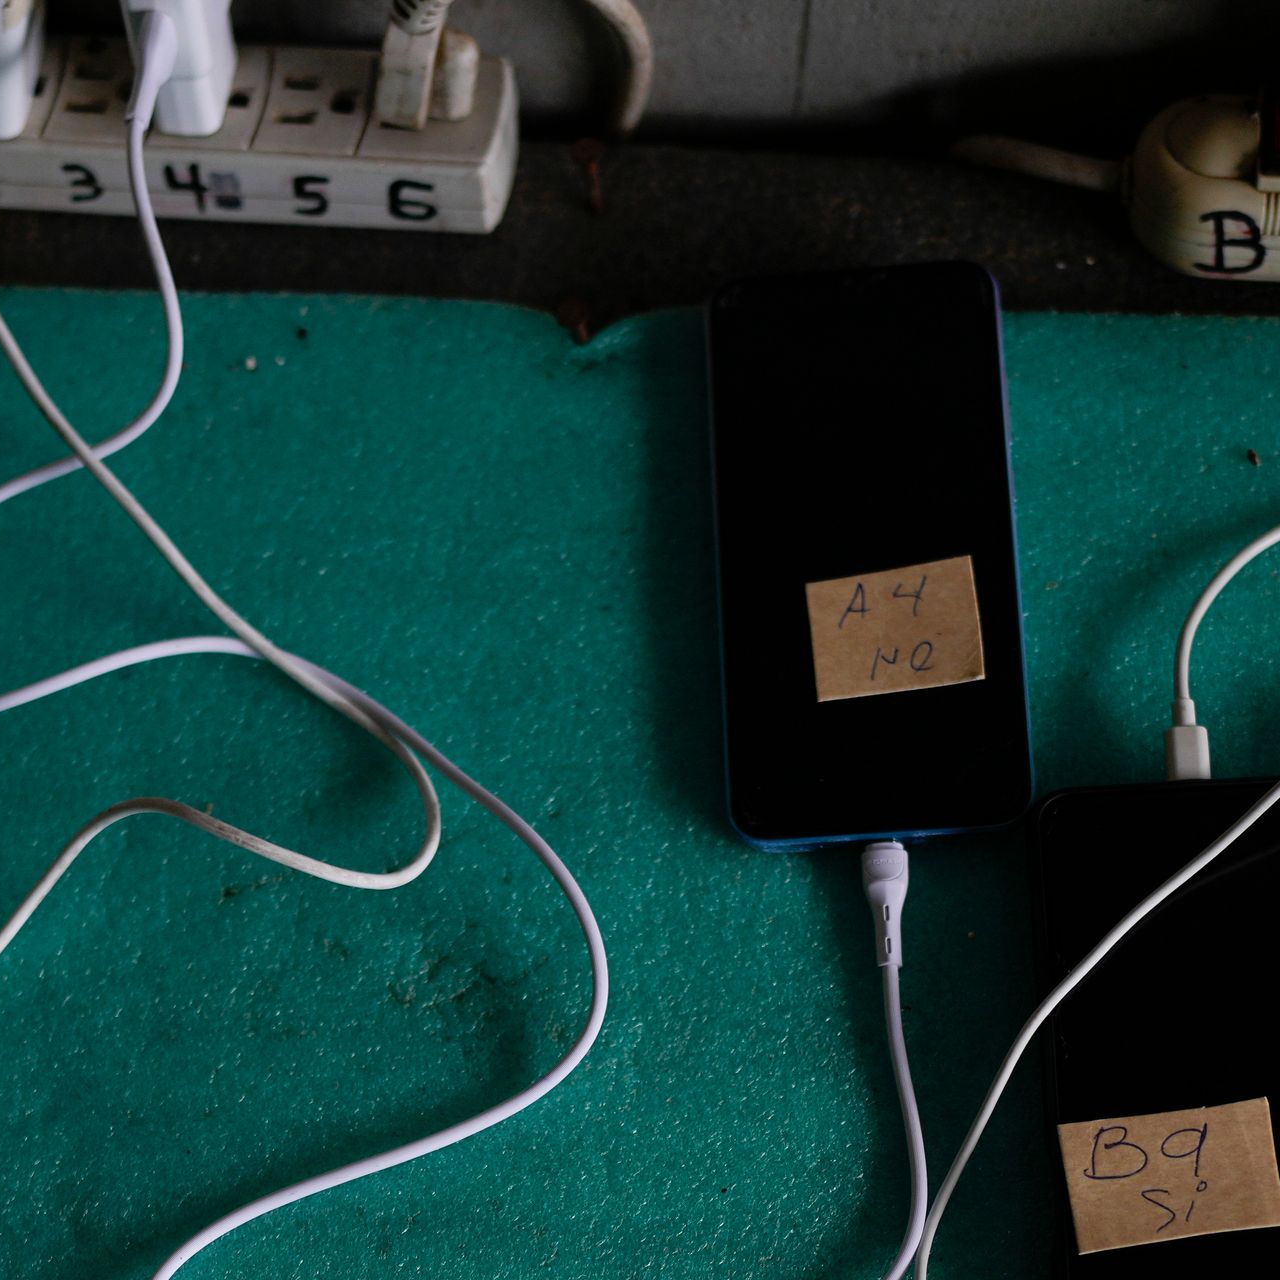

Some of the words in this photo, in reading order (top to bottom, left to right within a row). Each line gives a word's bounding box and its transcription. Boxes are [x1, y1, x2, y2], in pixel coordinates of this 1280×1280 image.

[61, 163, 103, 202] 3
[164, 162, 207, 214] 4
[293, 175, 330, 217] 5
[388, 178, 438, 221] 6
[1192, 210, 1267, 275] B
[1083, 1122, 1208, 1180] B9
